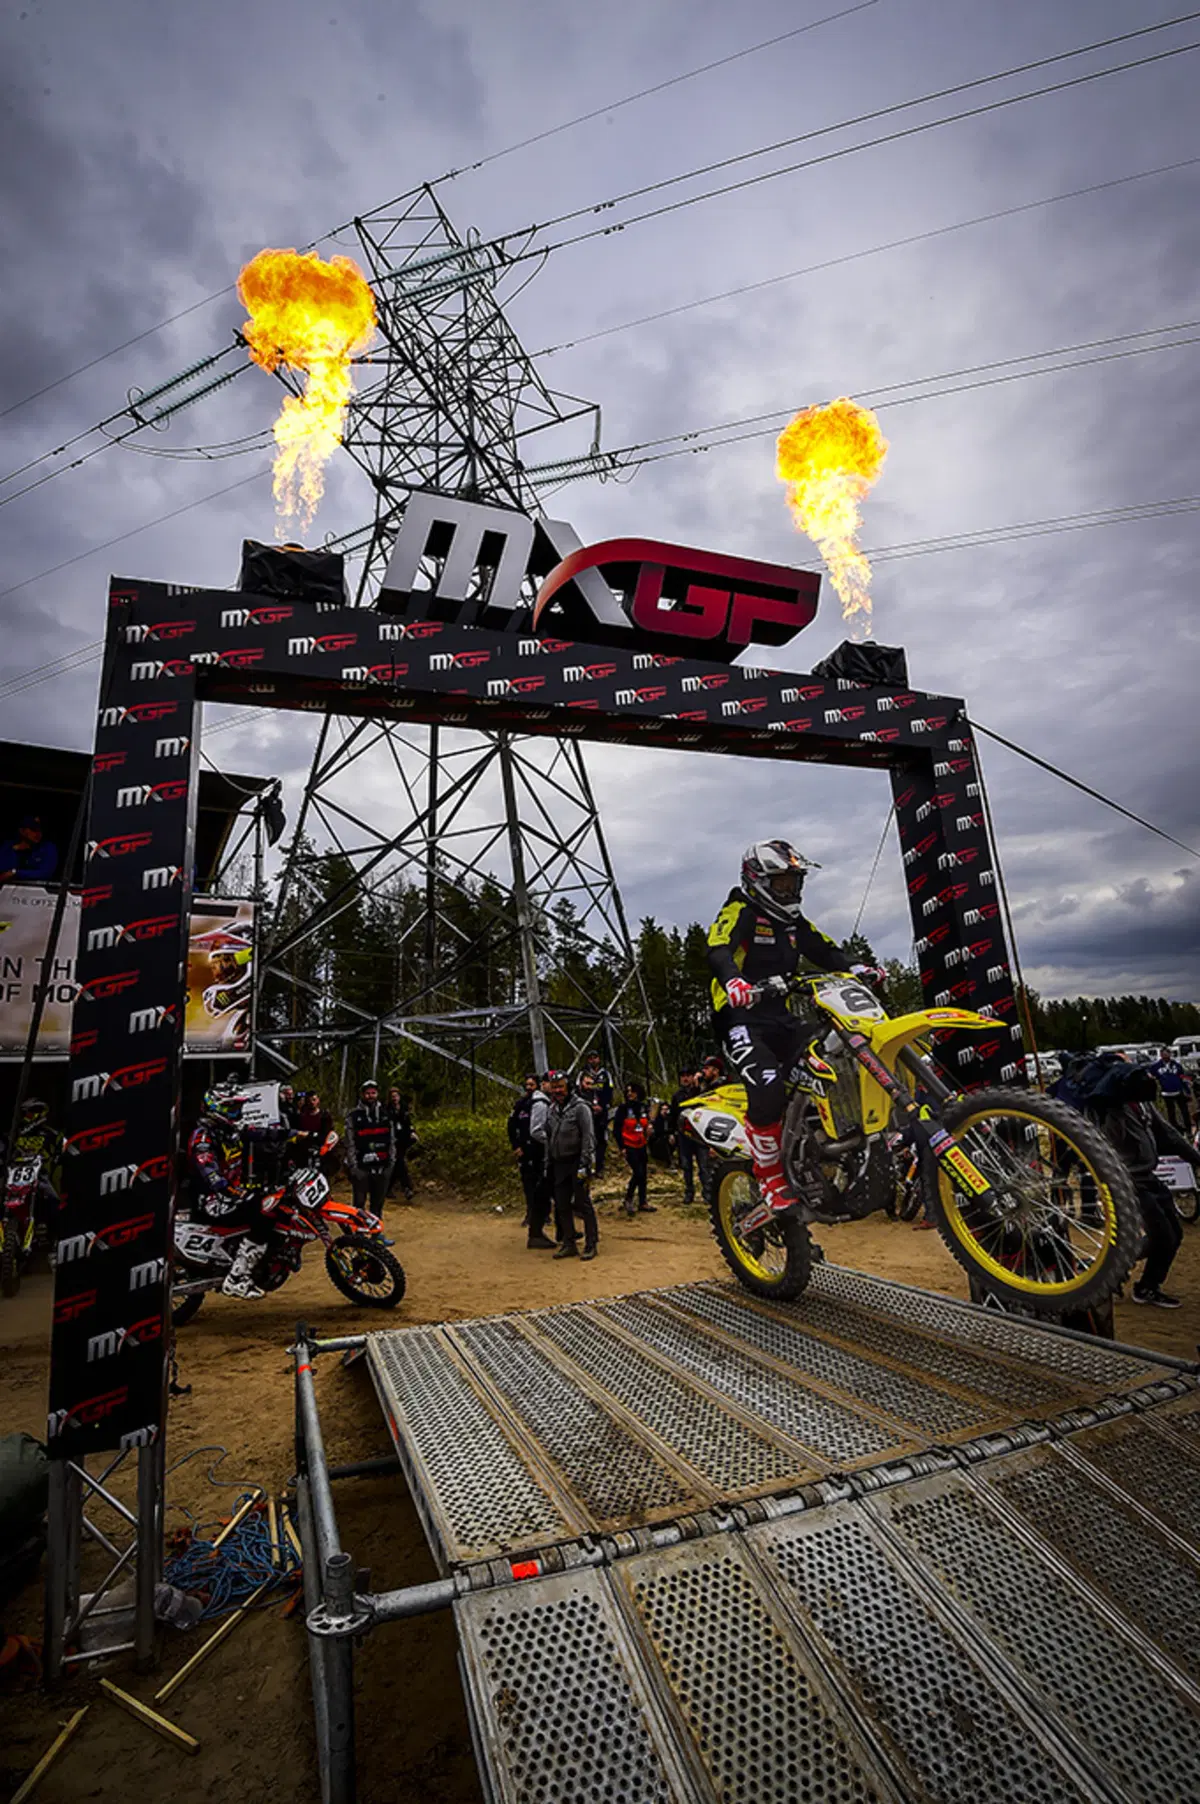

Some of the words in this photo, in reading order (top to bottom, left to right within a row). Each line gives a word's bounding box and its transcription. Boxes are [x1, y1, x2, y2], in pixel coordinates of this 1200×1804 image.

[379, 490, 822, 645] MXGP
[220, 605, 294, 628] MXGP
[378, 621, 444, 642] MXGP
[287, 633, 358, 655] MXGP
[130, 659, 195, 681] MXG
[429, 650, 491, 671] MXGP
[342, 663, 409, 684] MXGP
[563, 663, 617, 682] MXGP
[681, 673, 730, 692] MXGP
[487, 675, 546, 696] MXGP
[615, 685, 667, 705] MXGP
[780, 685, 825, 704] MXGP
[721, 697, 768, 716] MXGP
[876, 693, 917, 712] MXGP
[824, 705, 866, 724] MXGP
[910, 716, 948, 733] MXGP
[933, 758, 972, 777] MXGP
[84, 831, 153, 863] XGP
[86, 914, 180, 953] MXGP
[73, 969, 140, 1004] XGP
[957, 1039, 1001, 1067] MXGP
[72, 1057, 168, 1103] MXGP
[63, 1119, 127, 1157] XGP
[705, 1117, 736, 1142] 8
[12, 1167, 33, 1184] 63
[100, 1155, 169, 1197] MXG
[950, 1149, 985, 1190] PIRELLI
[304, 1181, 327, 1202] 24
[57, 1212, 156, 1265] MXGP
[185, 1234, 215, 1252] 24
[87, 1313, 163, 1363] MXG
